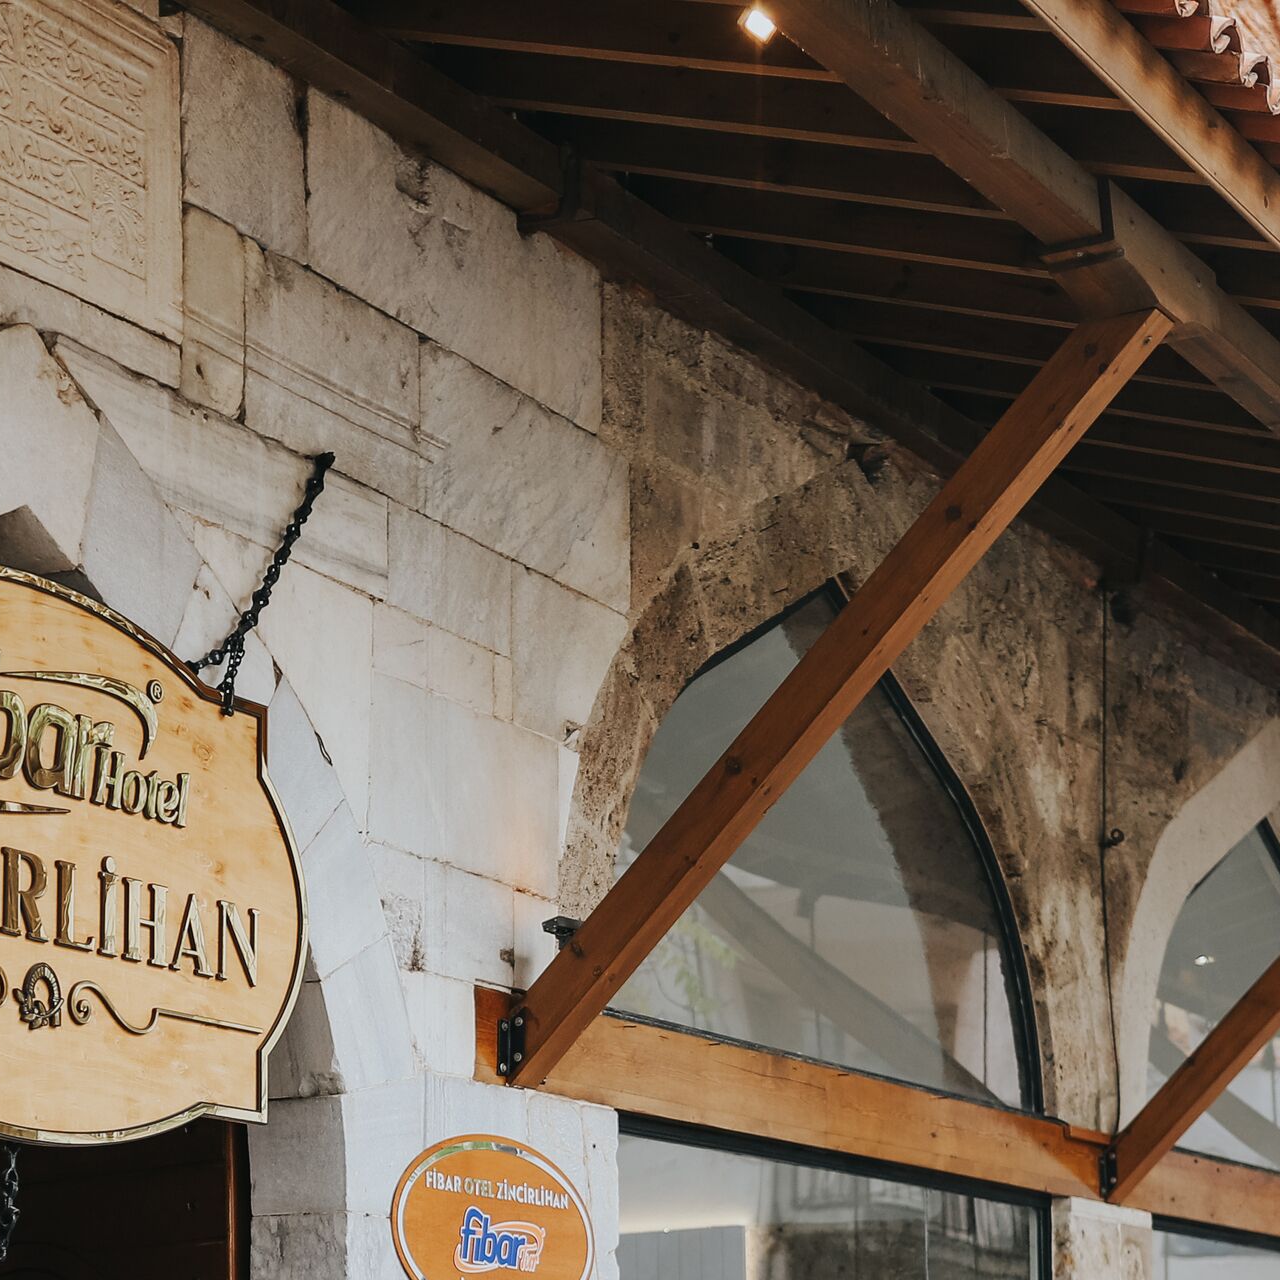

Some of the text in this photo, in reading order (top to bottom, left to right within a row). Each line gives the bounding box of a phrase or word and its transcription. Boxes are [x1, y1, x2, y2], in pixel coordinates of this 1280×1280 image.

[89, 747, 191, 828] Hotel
[425, 1168, 569, 1210] FİBAR OTEL ZİNCİRLİHAN
